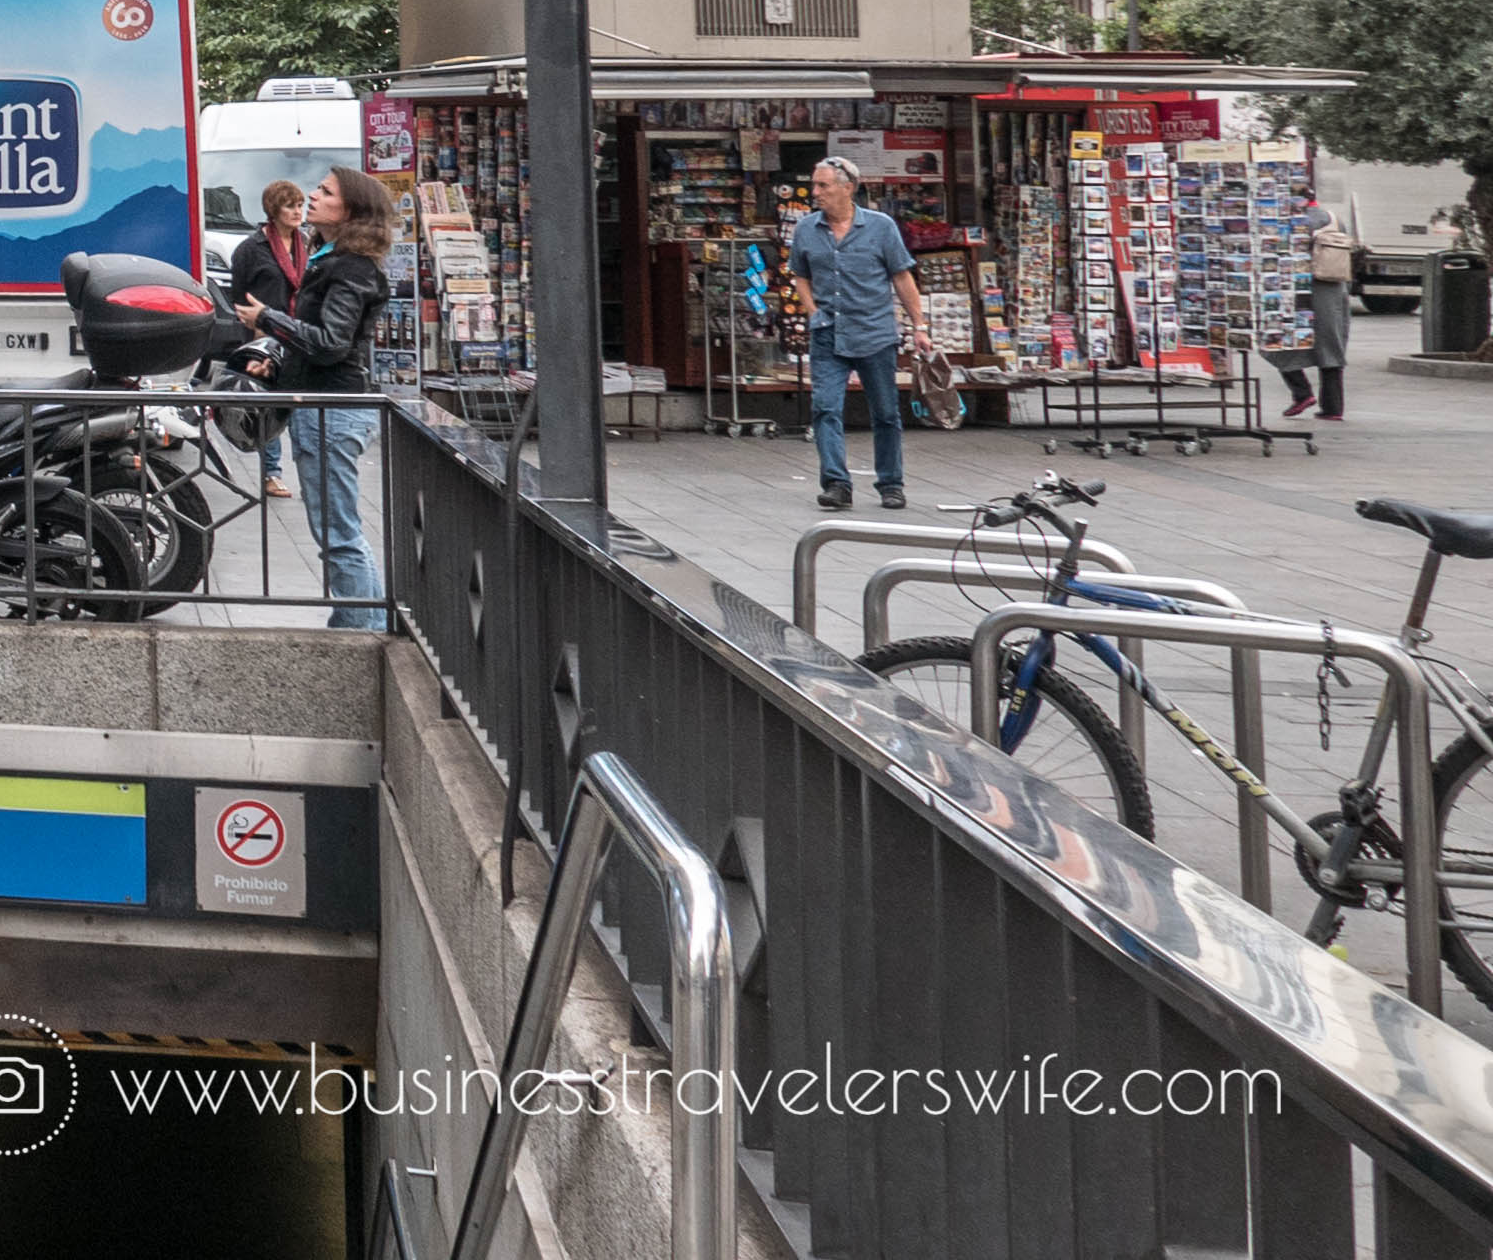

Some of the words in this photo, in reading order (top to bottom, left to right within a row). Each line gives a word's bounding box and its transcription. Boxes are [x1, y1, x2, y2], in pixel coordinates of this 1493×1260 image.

[6, 333, 37, 349] GXW
[214, 874, 289, 892] Prohibido
[226, 889, 277, 905] Fumar
